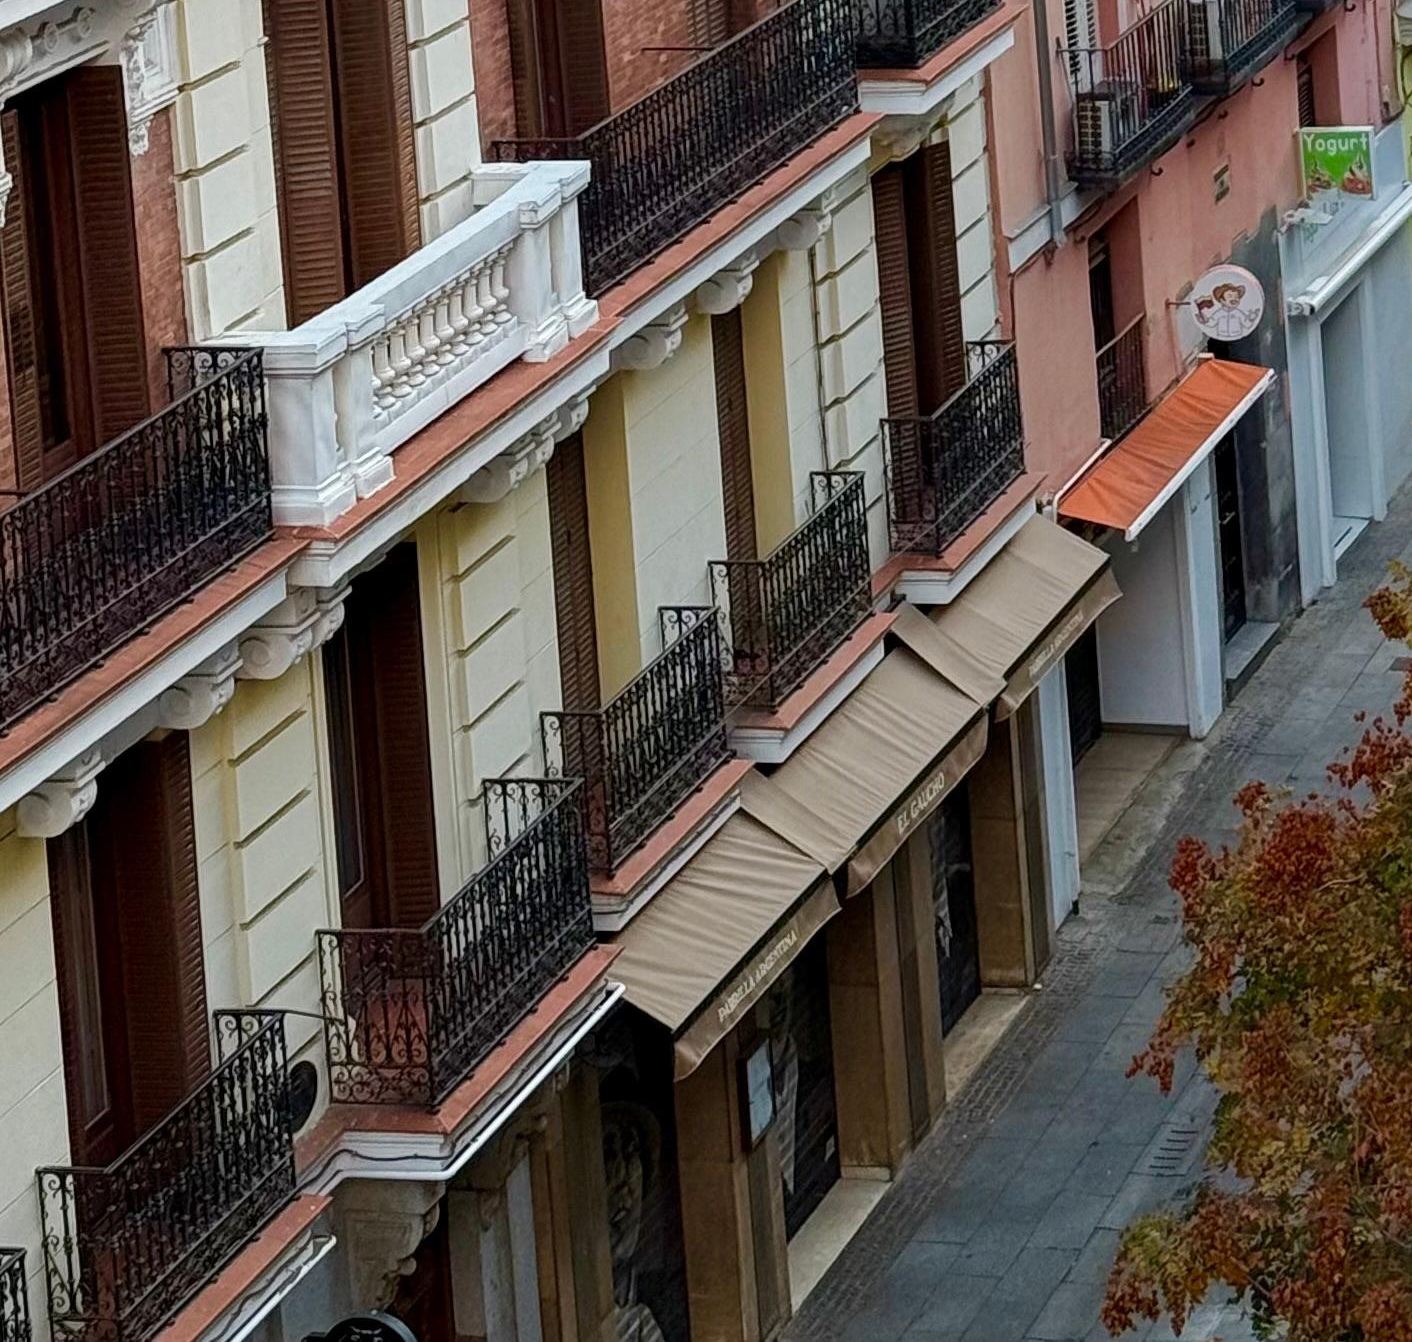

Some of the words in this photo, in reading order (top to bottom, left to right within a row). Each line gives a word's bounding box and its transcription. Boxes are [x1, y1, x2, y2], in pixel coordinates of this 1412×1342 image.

[1303, 133, 1368, 156] Yogurt
[897, 811, 910, 834] EL
[911, 771, 945, 819] GAUCHO
